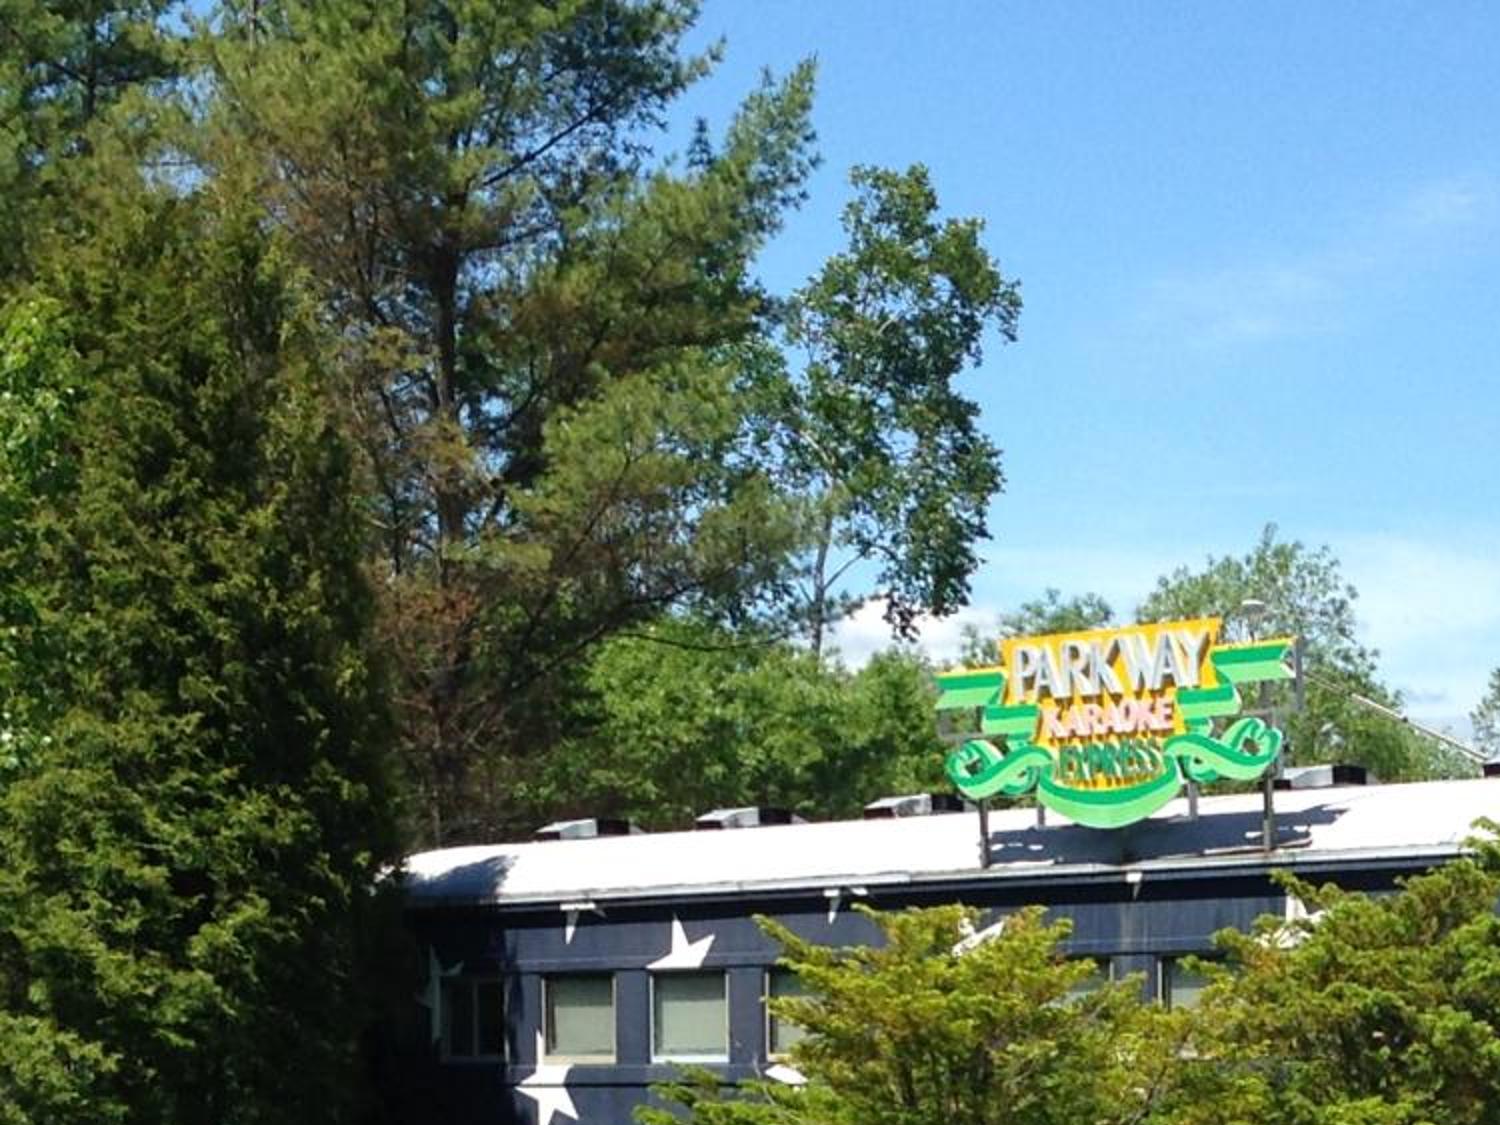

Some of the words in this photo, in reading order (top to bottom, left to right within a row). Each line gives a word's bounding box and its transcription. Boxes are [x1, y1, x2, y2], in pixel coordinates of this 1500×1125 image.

[1014, 629, 1209, 699] PARKWAY
[1044, 698, 1175, 738] KARAOKE
[1058, 737, 1162, 782] EXPRESS
